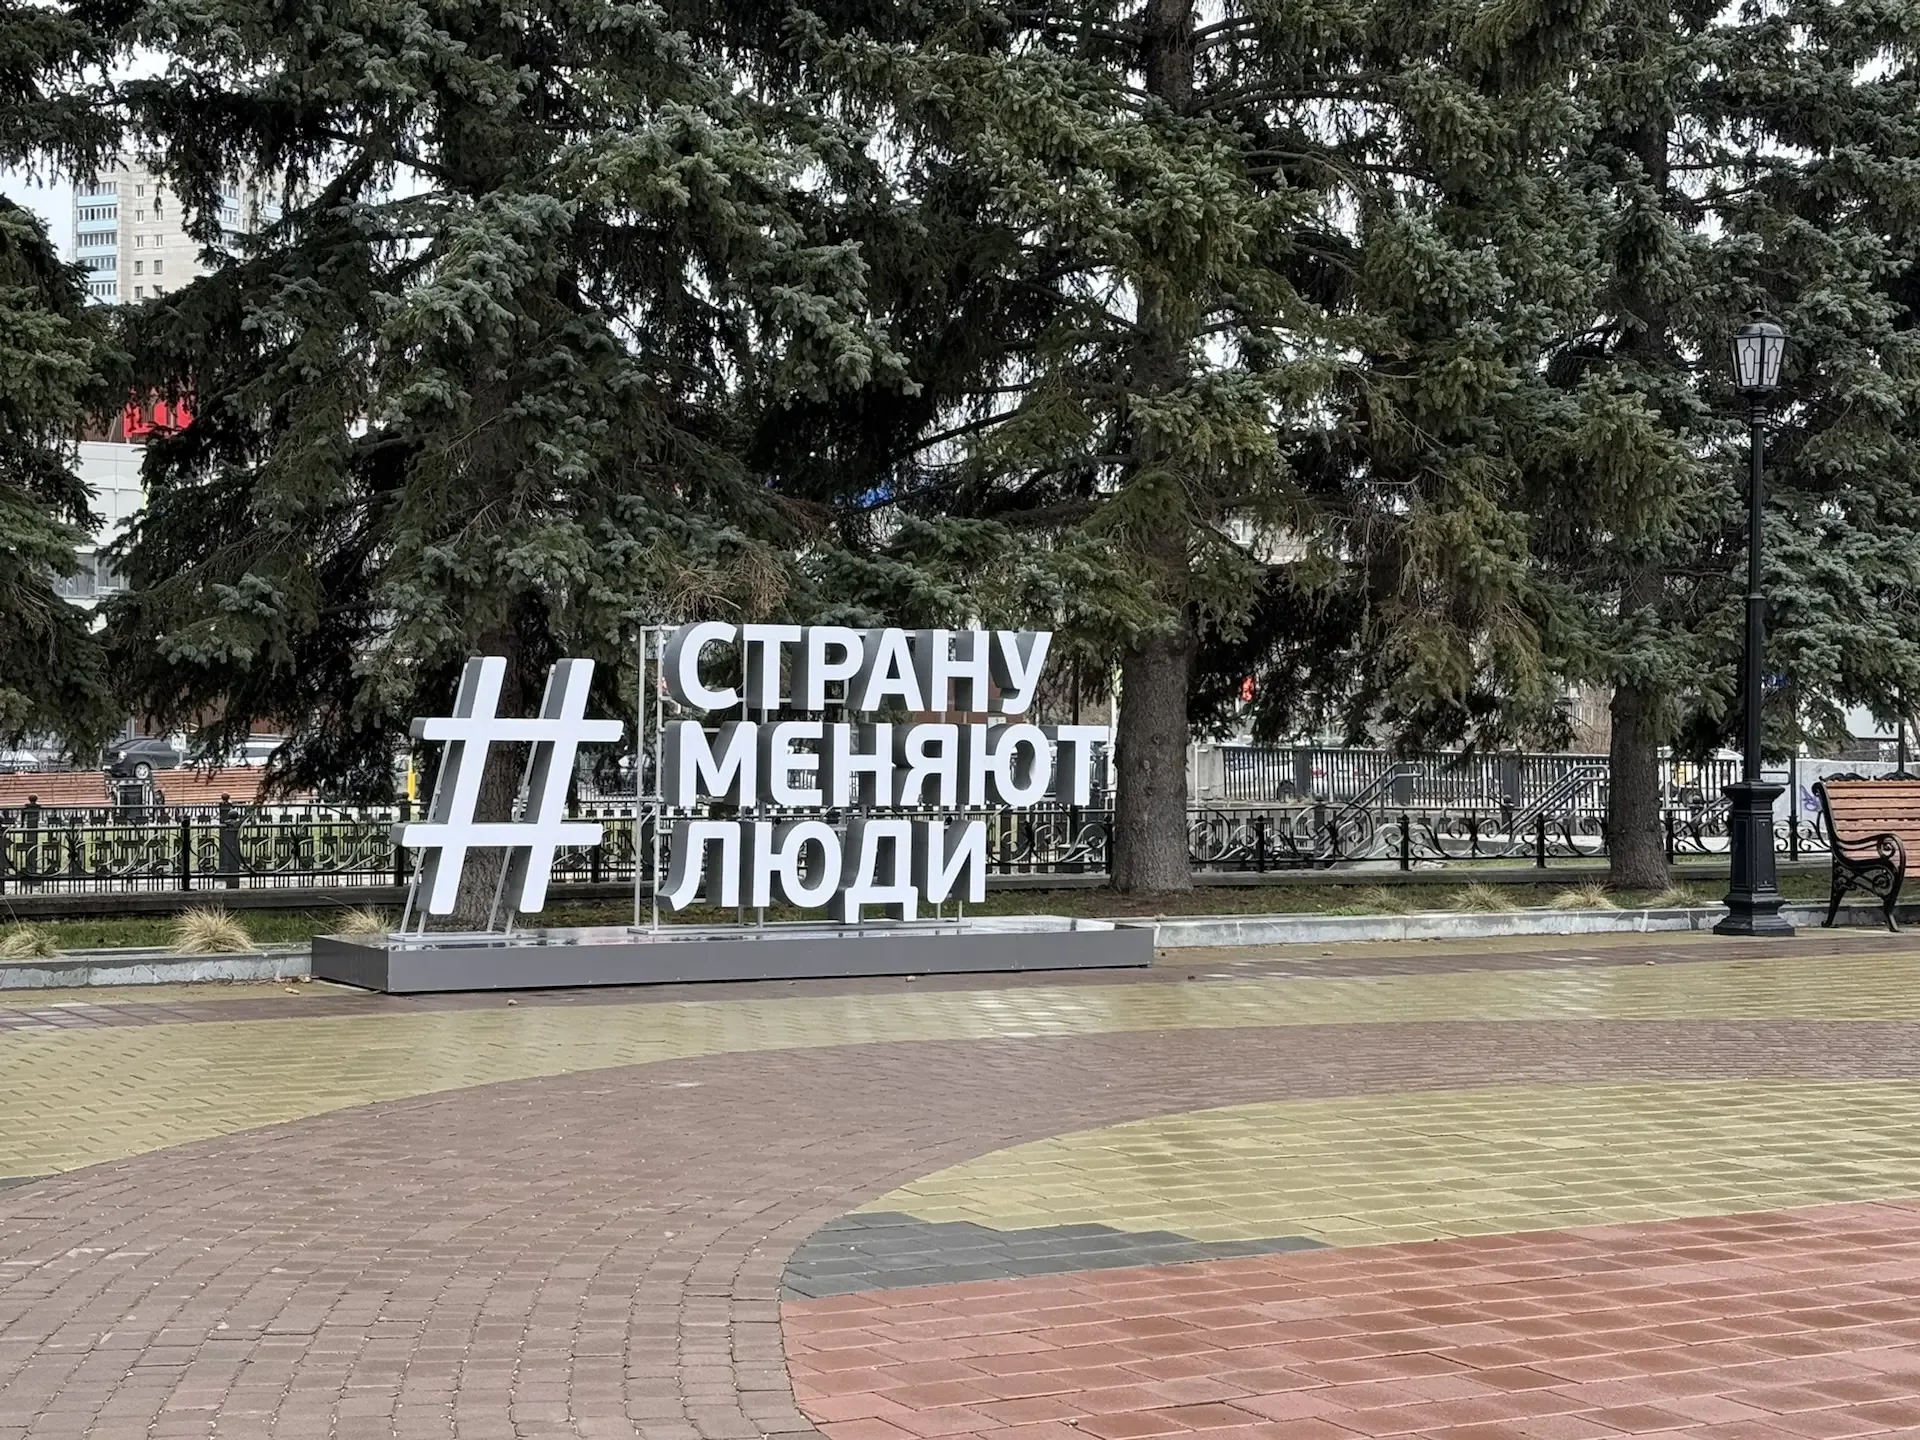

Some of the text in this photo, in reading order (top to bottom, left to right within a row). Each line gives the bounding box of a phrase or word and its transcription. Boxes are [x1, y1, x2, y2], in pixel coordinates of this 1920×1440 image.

[679, 621, 1053, 715] СТРАНУ
[678, 721, 1109, 810] МЕНЯЮТ
[670, 820, 987, 923] ЛЮДИ
